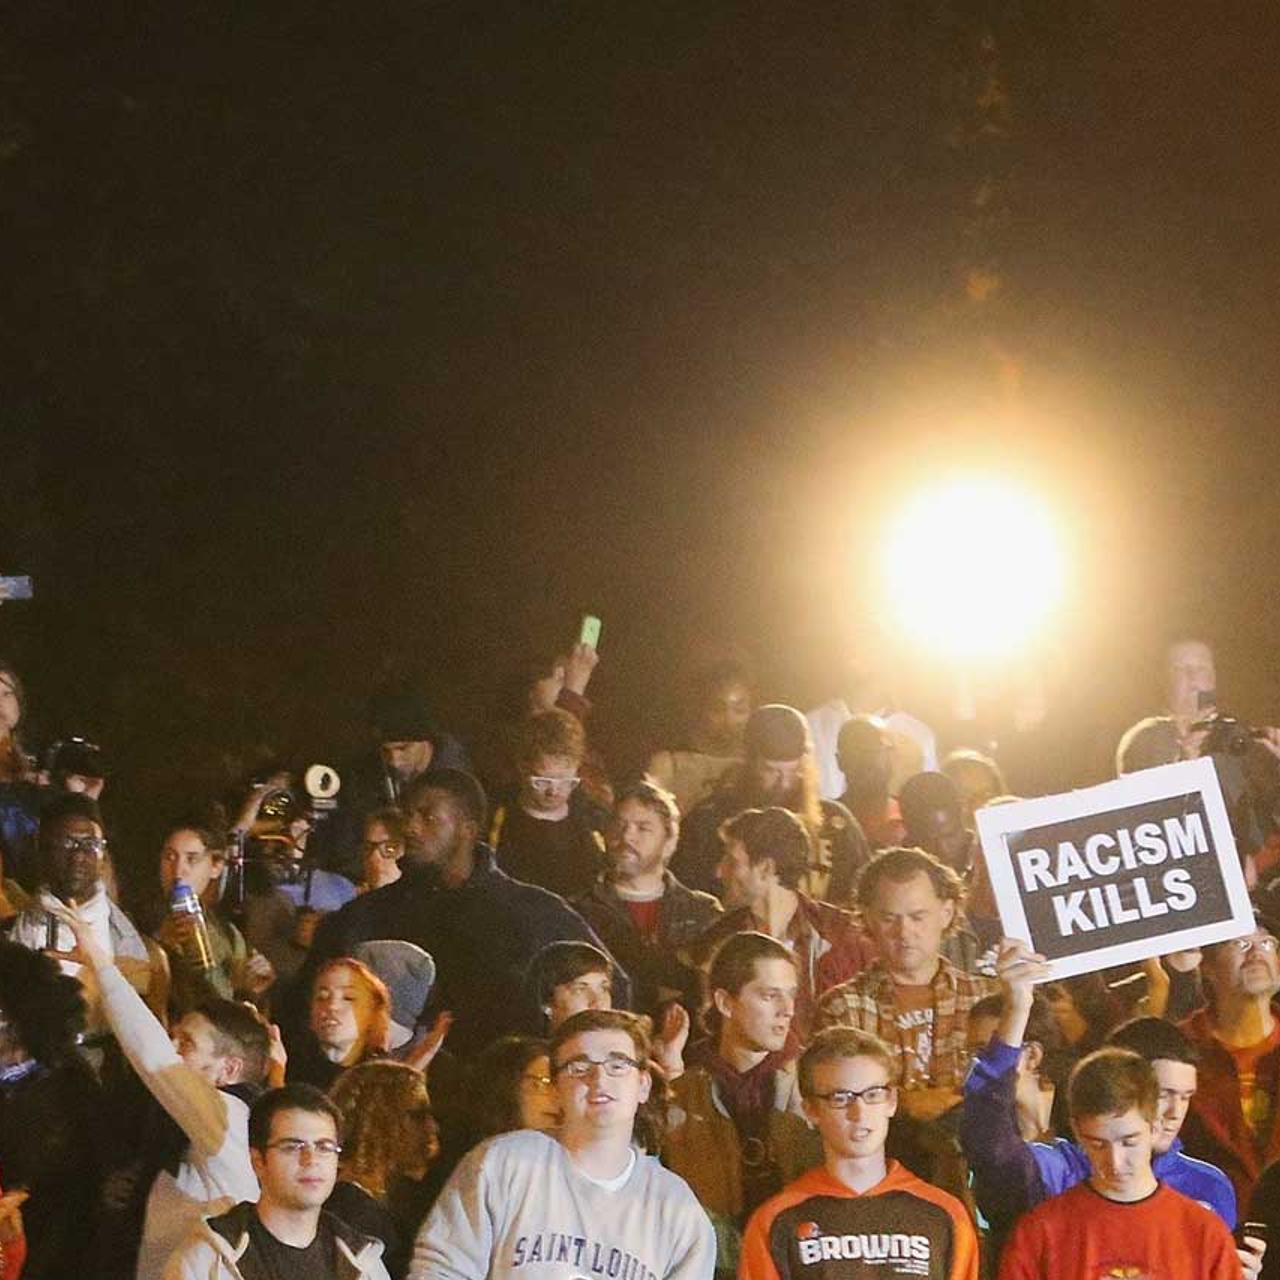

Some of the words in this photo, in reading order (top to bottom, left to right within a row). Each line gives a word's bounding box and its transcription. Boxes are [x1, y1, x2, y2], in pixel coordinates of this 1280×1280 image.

[1016, 813, 1209, 892] RACISM
[1051, 868, 1198, 936] KILLS
[511, 1233, 587, 1268] SAINT
[798, 1234, 930, 1266] BROWNS
